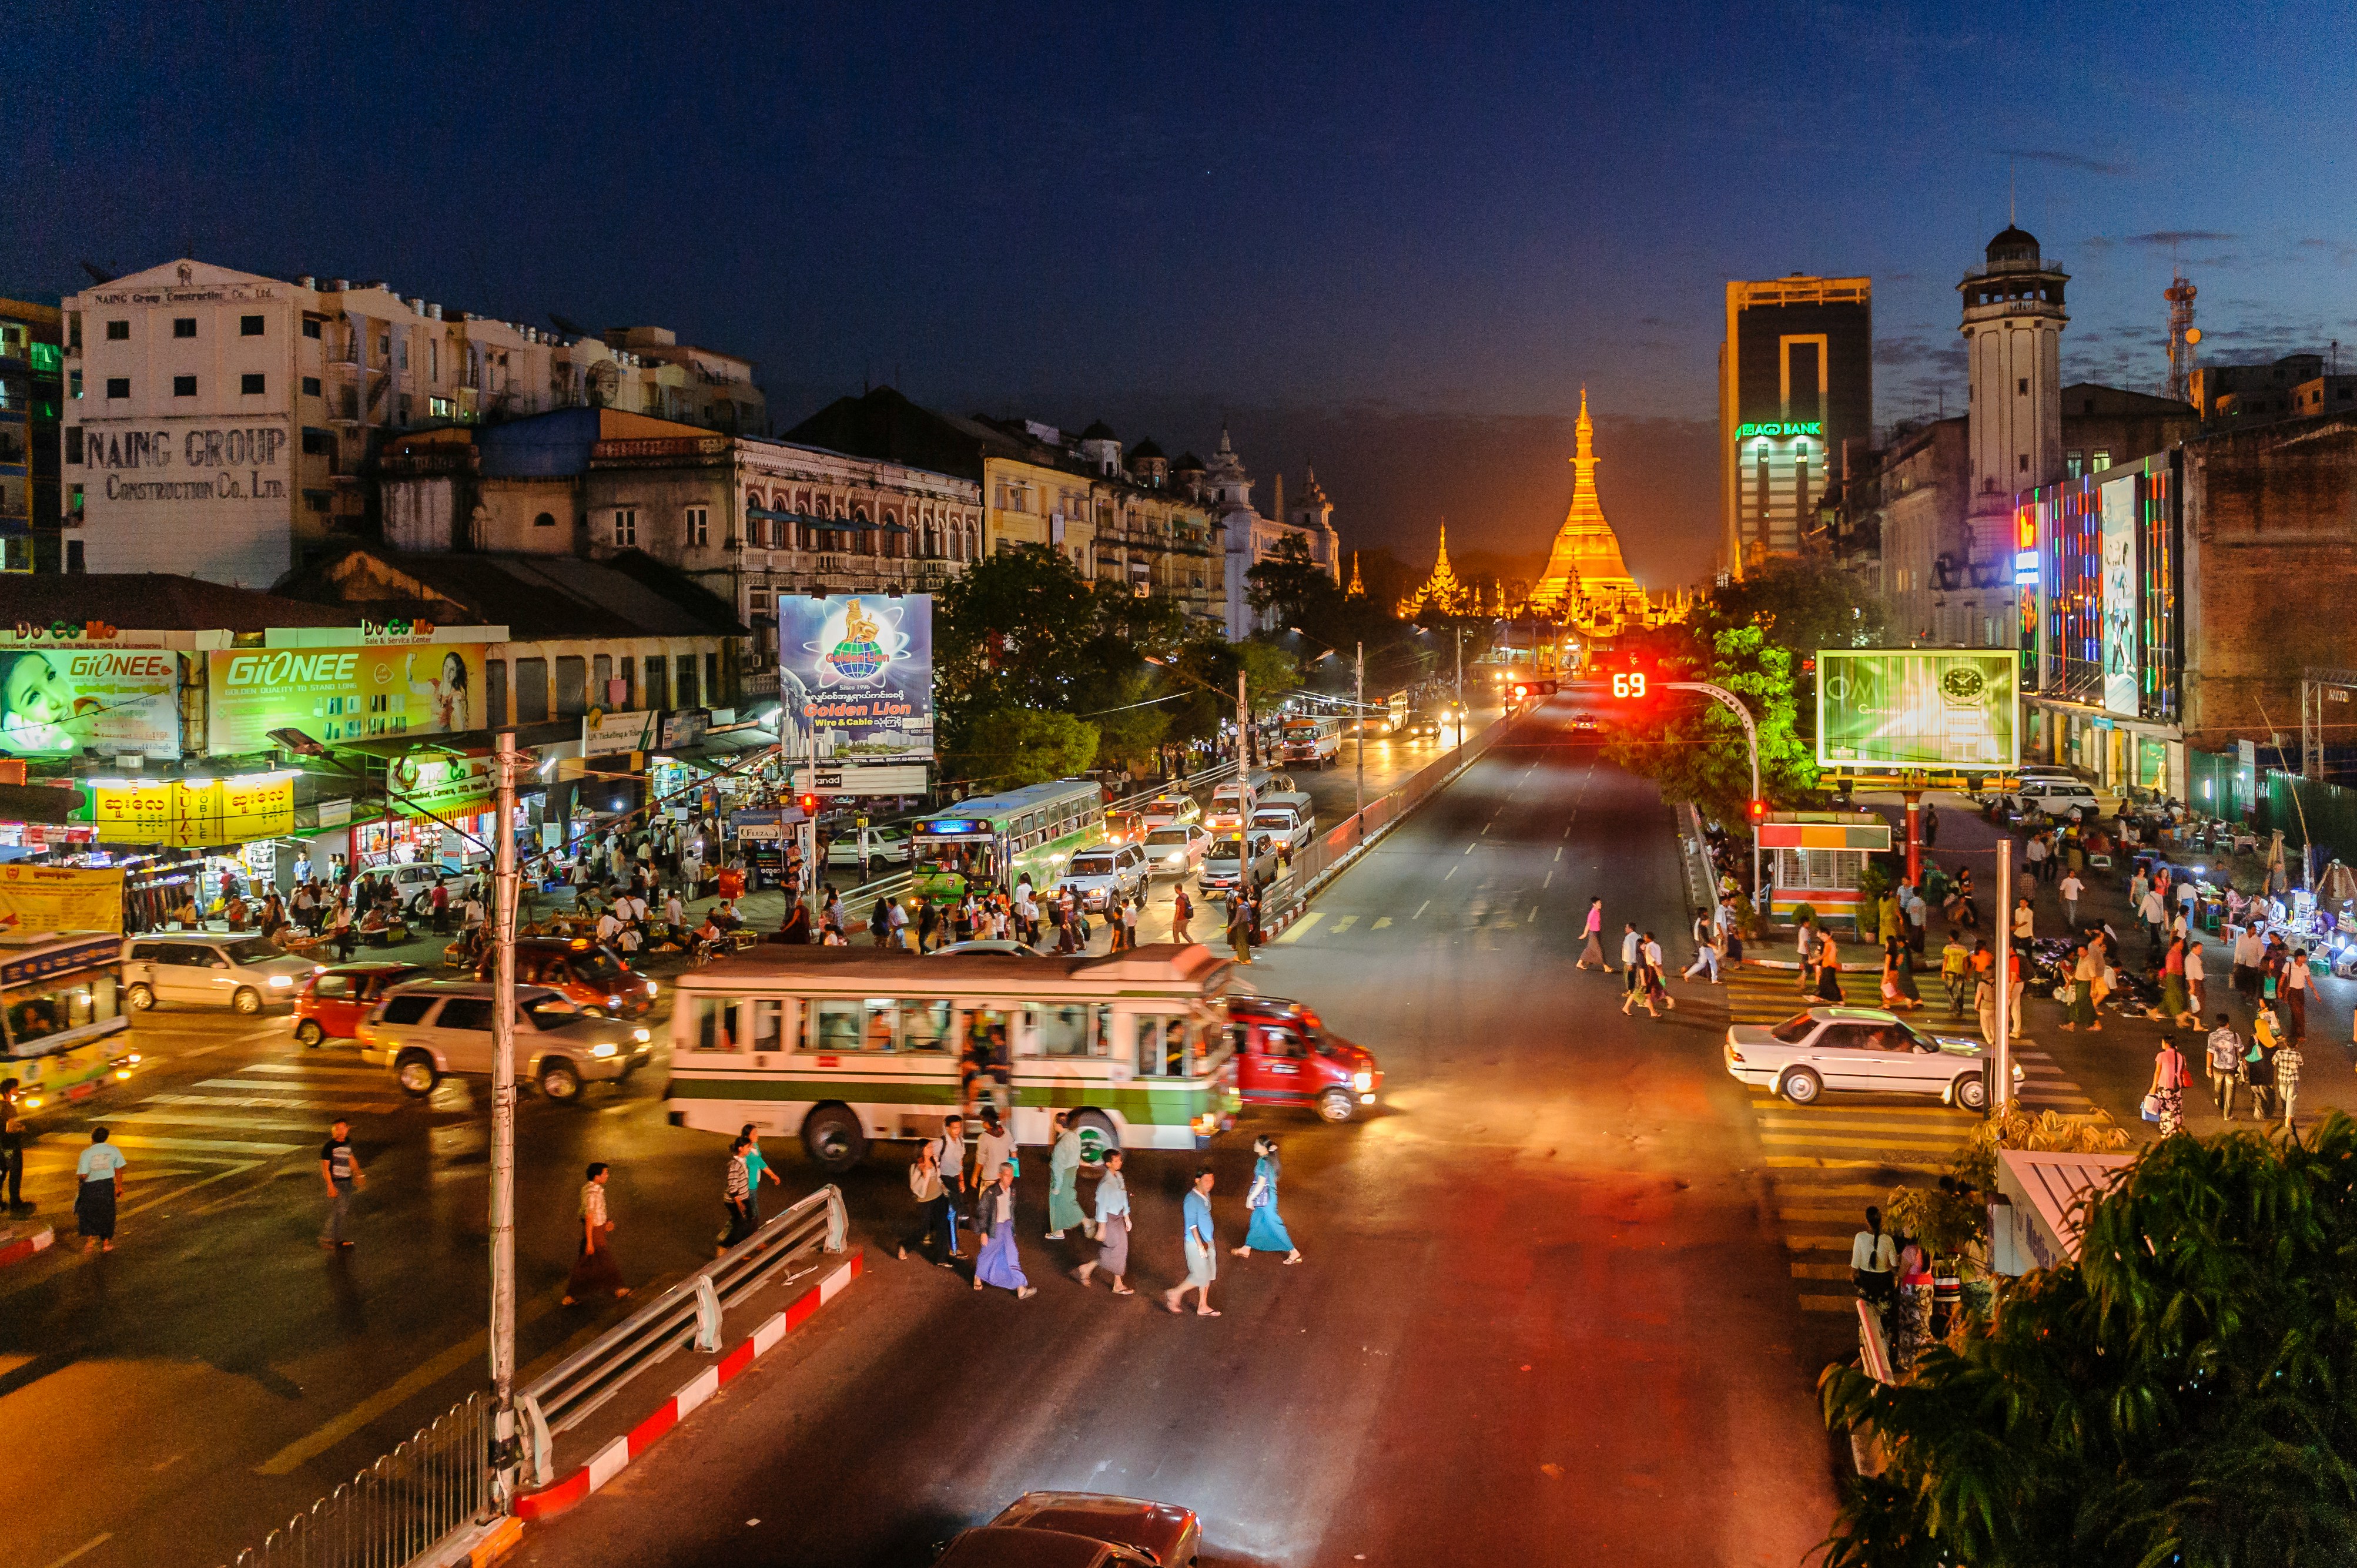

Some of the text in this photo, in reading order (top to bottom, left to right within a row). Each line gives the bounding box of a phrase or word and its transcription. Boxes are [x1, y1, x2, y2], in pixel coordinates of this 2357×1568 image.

[1783, 422, 1821, 435] BANK
[88, 428, 286, 469] NAING GROUP
[51, 620, 80, 639] Co
[362, 618, 383, 636] Do
[388, 618, 409, 635] Co
[825, 652, 889, 663] Golden Lion
[1613, 673, 1645, 698] 69
[803, 702, 911, 717] Golden Lion
[846, 718, 873, 726] Cable
[179, 784, 193, 845] SULAY
[200, 788, 208, 839] MOBILE
